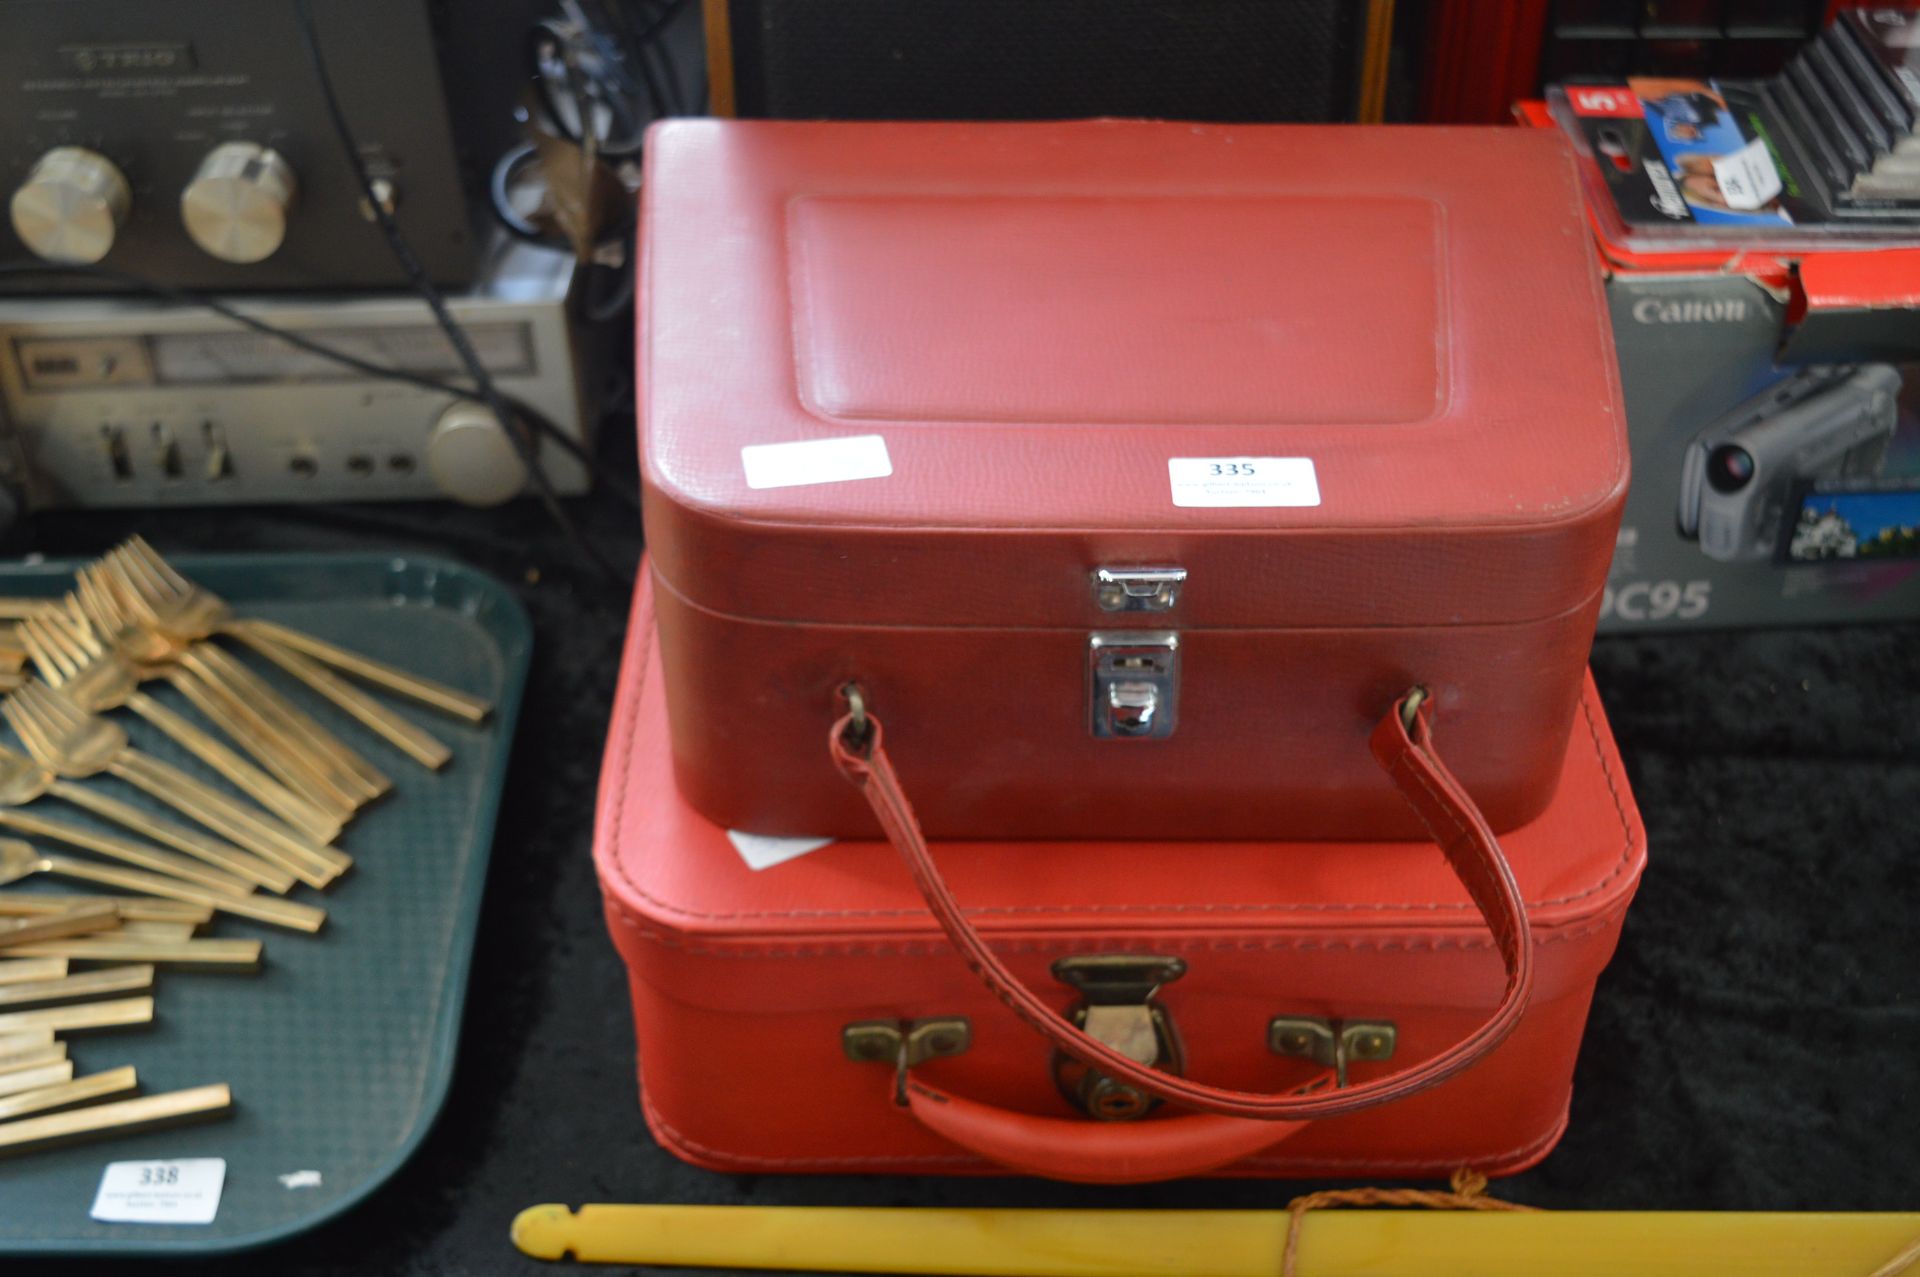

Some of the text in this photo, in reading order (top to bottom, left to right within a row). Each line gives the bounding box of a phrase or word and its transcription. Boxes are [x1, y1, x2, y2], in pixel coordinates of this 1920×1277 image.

[100, 51, 176, 68] TRIO
[1578, 91, 1617, 111] 5
[1632, 299, 1746, 324] Canon
[1209, 463, 1256, 477] 335
[140, 1166, 180, 1186] 338
